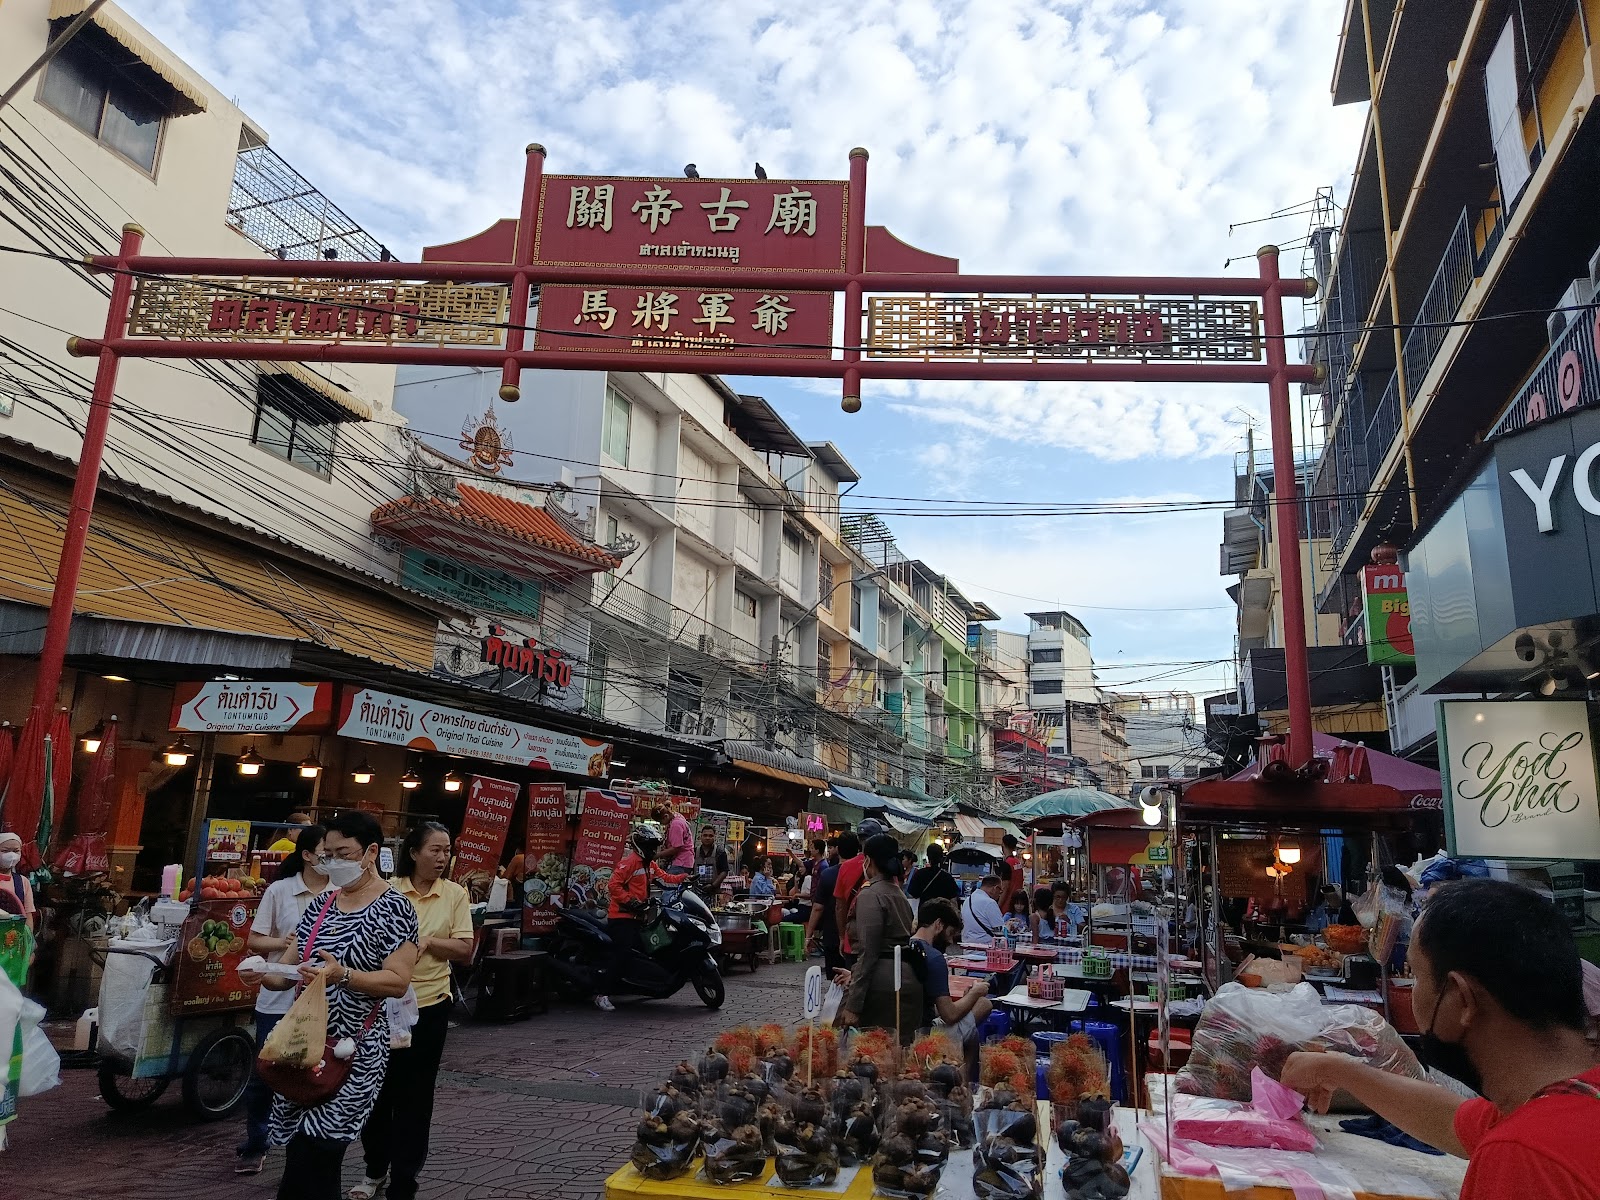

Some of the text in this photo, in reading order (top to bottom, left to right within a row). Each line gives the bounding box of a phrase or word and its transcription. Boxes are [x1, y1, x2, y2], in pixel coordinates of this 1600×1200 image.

[566, 184, 818, 238] 關帝古廟
[639, 240, 740, 264] ศาลเจ้ากวนอู
[573, 290, 796, 337] 馬將軍爺
[1382, 598, 1410, 617] Big
[484, 623, 571, 688] ต้นตำรับ
[217, 684, 278, 710] ต้นตำรับ
[359, 692, 414, 732] ต้นตำรับ
[206, 722, 281, 732] Original Thai Cuisine
[431, 709, 512, 738] อาหารไทย ต้นตำรับ
[436, 727, 504, 749] Original Thai Cuisine
[1457, 731, 1584, 800] Yod
[478, 796, 513, 810] หมูสามชั้น
[534, 794, 560, 805] ขนมจีน
[1480, 775, 1580, 828] Cha
[468, 807, 508, 823] ทอดน้ำปลา
[584, 806, 629, 820] ผัดไทยกุ้งสด
[1511, 808, 1554, 824] Brand
[465, 827, 499, 842] Fried-Pork
[583, 829, 622, 842] Pad Thai
[229, 991, 242, 1001] 50
[807, 974, 820, 1013] 80
